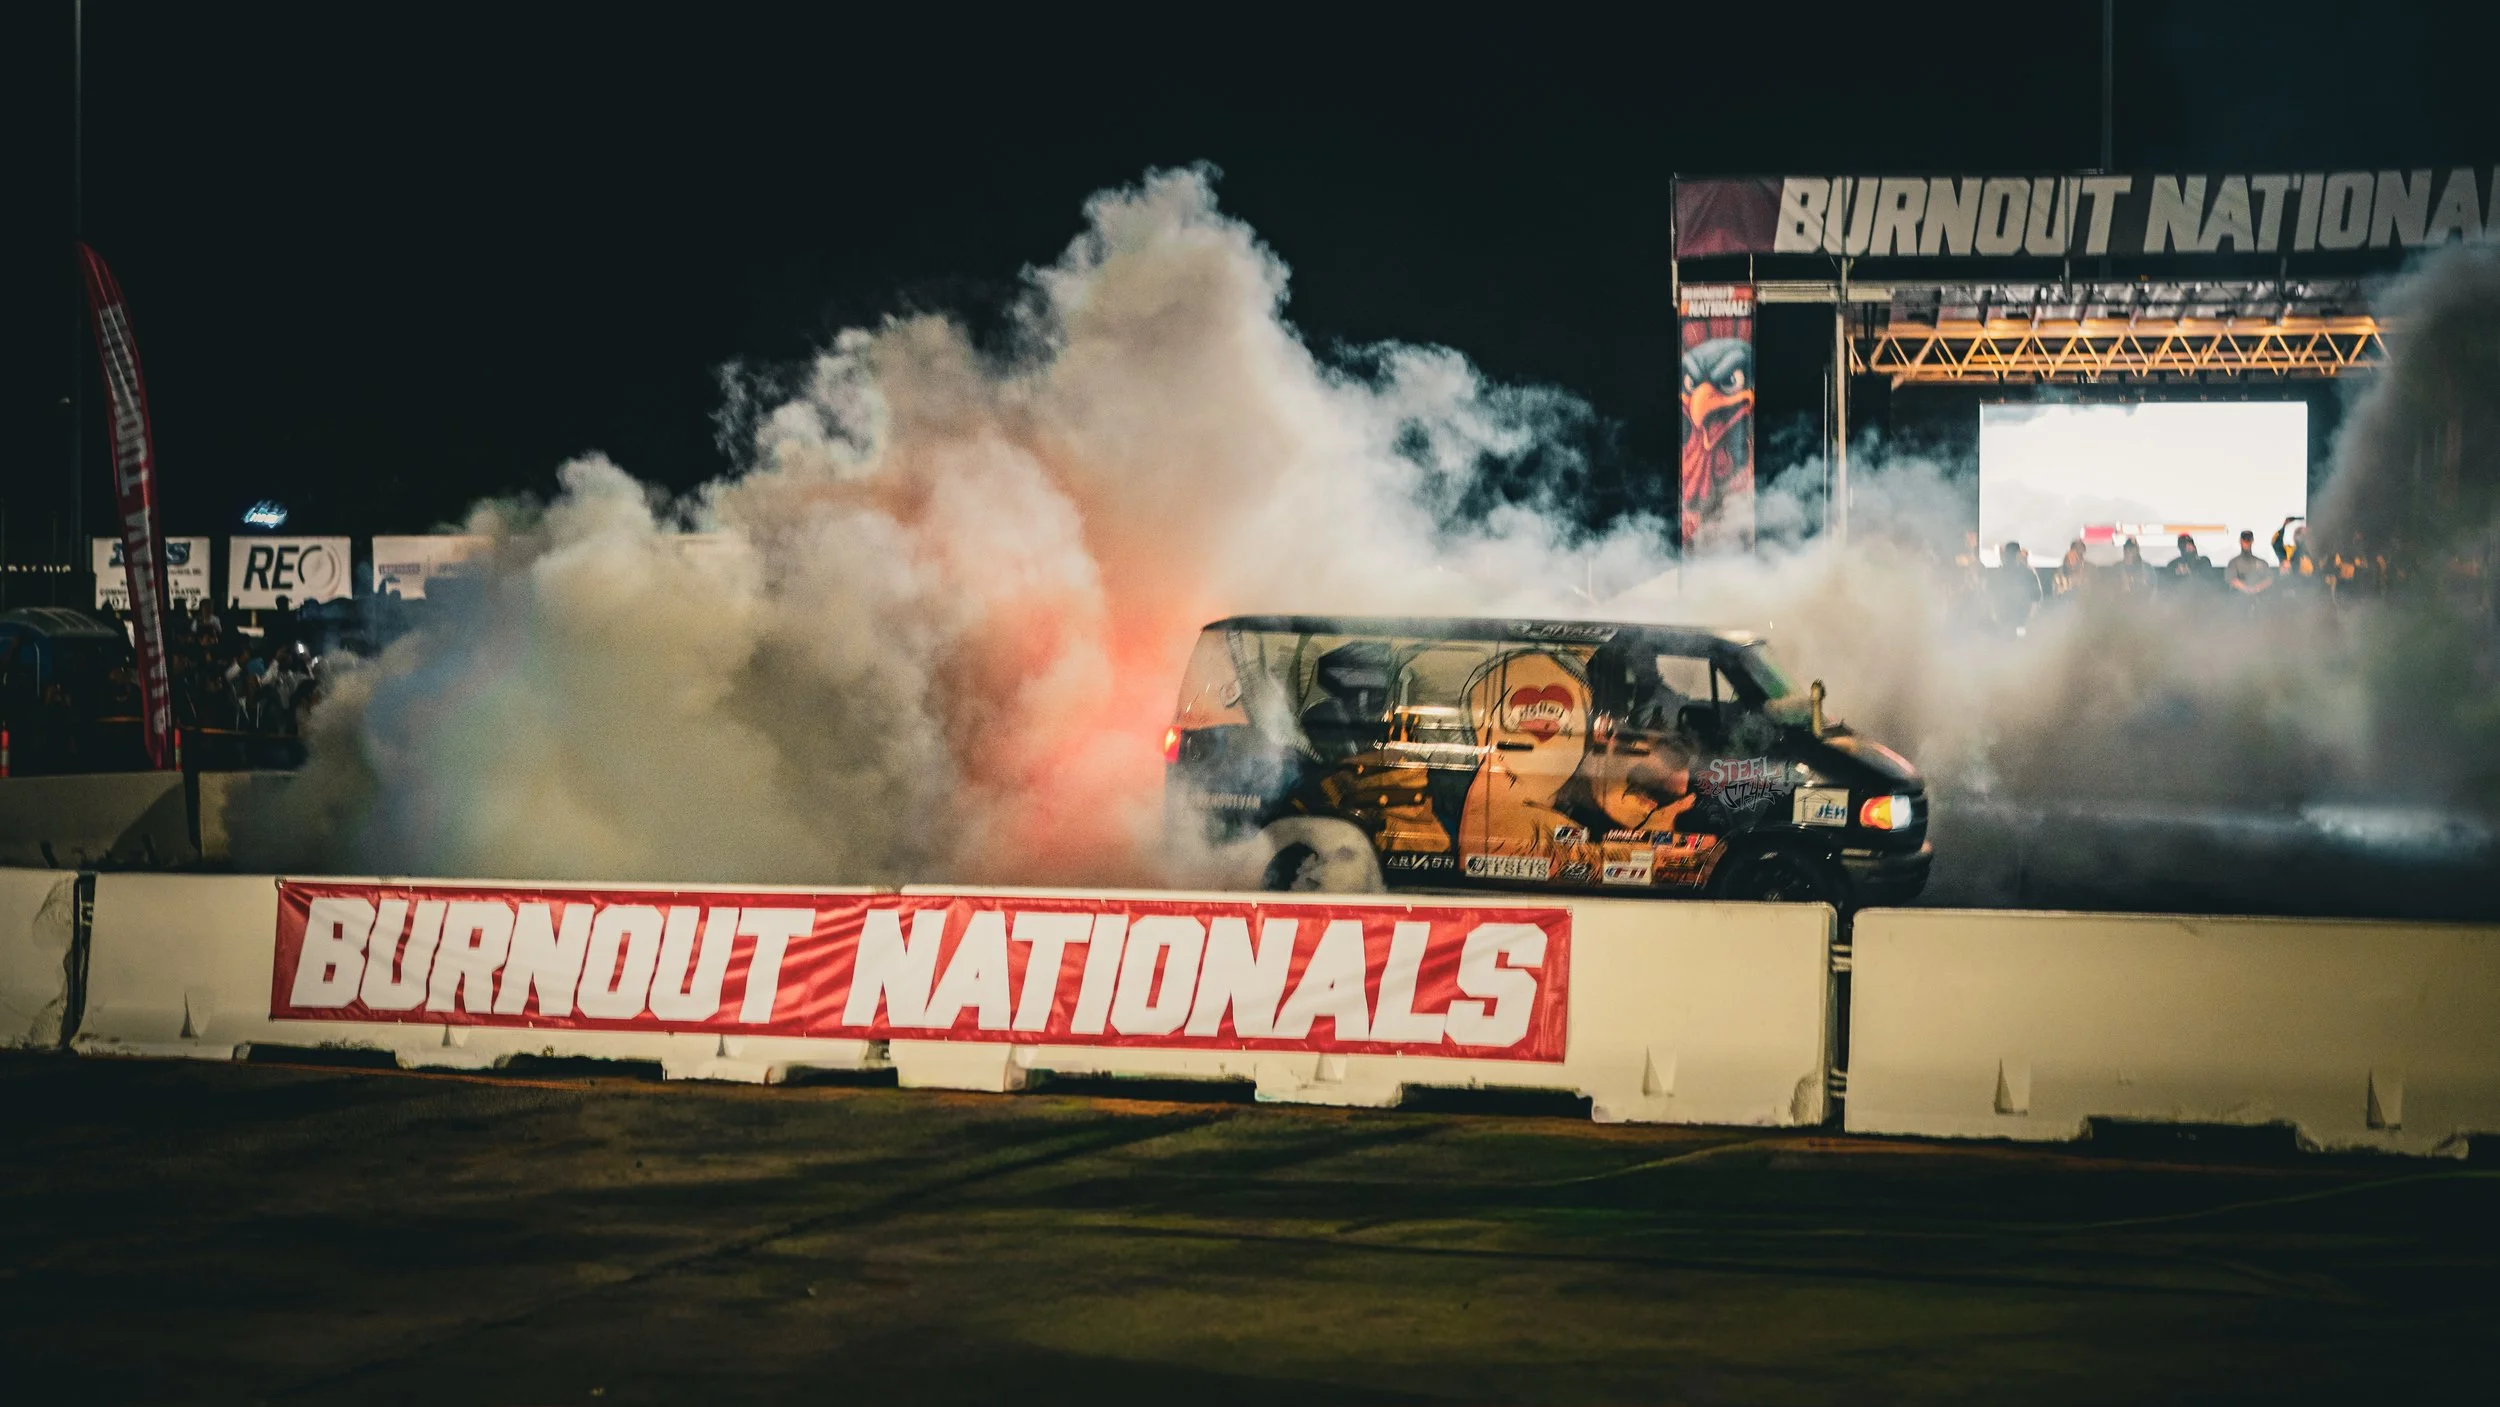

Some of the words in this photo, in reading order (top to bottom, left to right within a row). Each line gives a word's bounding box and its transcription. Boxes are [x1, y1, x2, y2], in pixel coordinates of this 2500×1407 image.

[1774, 176, 2132, 256] BURNOUT
[2142, 164, 2500, 254] NATIONA
[1709, 756, 1777, 784] STEEL
[289, 897, 816, 1025] BURNOUT
[841, 908, 1549, 1047] NATIONALS
